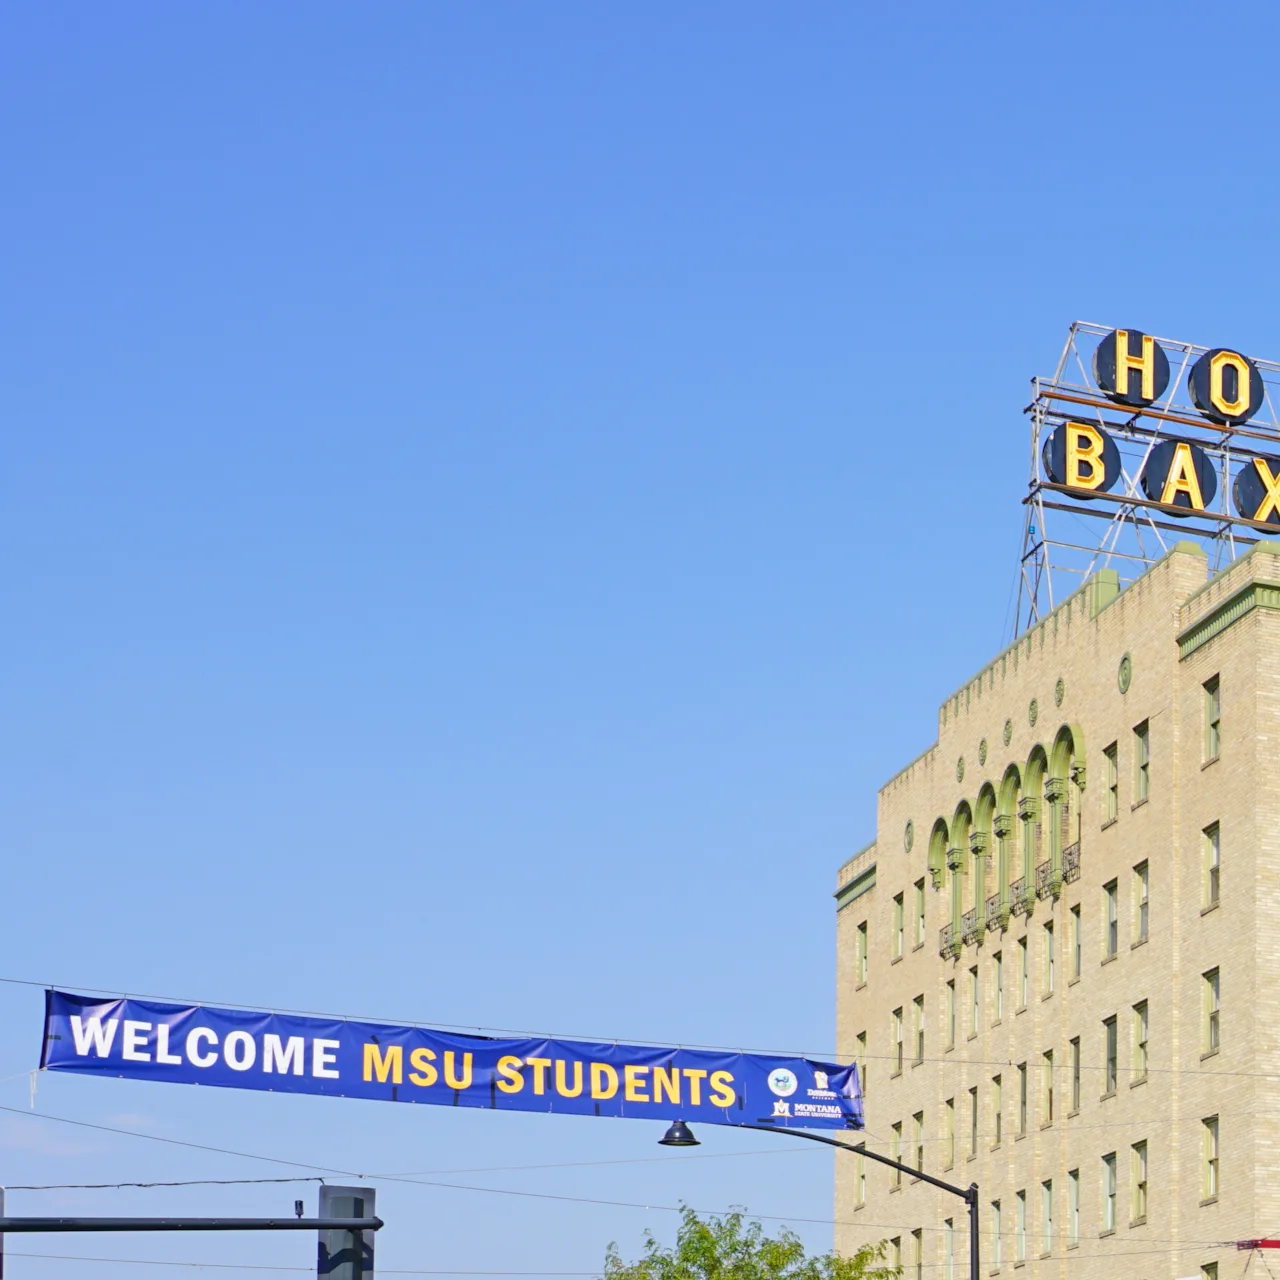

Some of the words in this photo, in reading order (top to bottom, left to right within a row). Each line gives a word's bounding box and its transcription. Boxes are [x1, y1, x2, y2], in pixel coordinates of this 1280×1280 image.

[70, 1013, 341, 1081] WELCOME
[361, 1042, 474, 1091] MSU
[496, 1054, 737, 1109] STUDENTS
[794, 1103, 841, 1113] MONTANA
